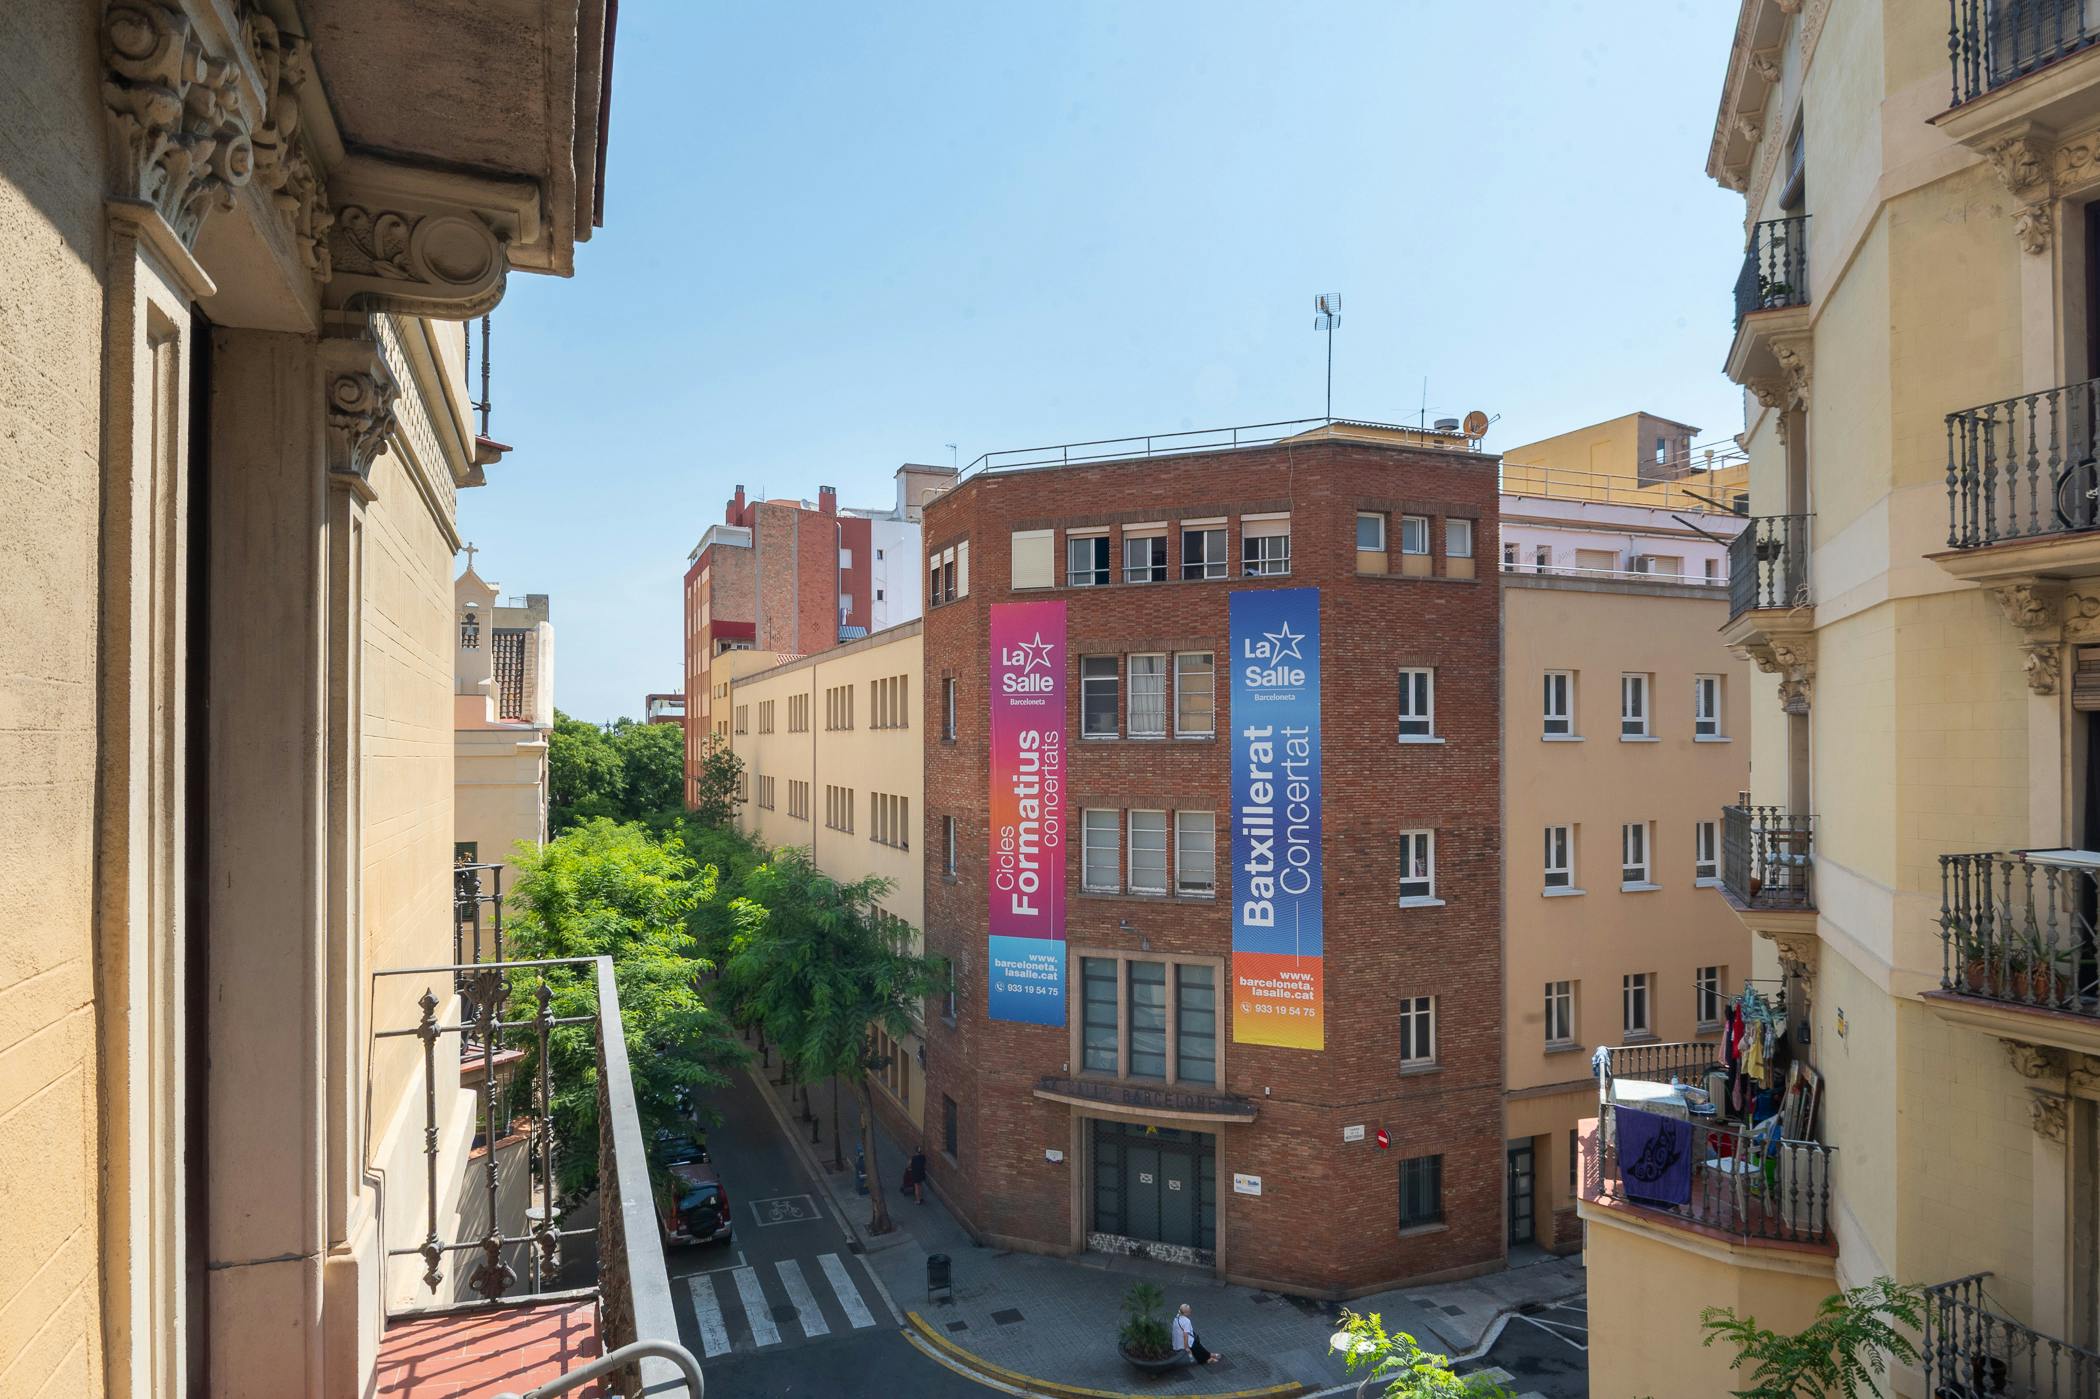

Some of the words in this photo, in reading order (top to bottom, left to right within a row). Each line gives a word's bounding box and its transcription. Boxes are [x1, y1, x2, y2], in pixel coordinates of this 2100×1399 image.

[1244, 638, 1270, 658] La
[1002, 647, 1025, 666] La
[1002, 672, 1054, 692] Salle
[1245, 666, 1306, 687] Salle
[1010, 698, 1046, 706] Barceloneta
[1254, 692, 1296, 702] Barceloneta
[1041, 730, 1059, 847] concertats
[1280, 725, 1311, 895] Concertat
[1012, 729, 1040, 916] Formatius
[1242, 725, 1275, 928] Batxillerat
[996, 825, 1015, 891] Cicles
[994, 958, 1058, 972] barceloneta.
[1029, 953, 1058, 963] www.
[1005, 967, 1058, 980] lasalle.cat
[1280, 971, 1314, 981] www.
[1007, 983, 1023, 993] 933
[1024, 985, 1034, 994] 19
[1035, 986, 1046, 995] 54
[1048, 987, 1059, 996] 75
[1240, 976, 1314, 991] barceloneta.
[1252, 987, 1314, 1000] lasalle.cat
[1255, 1004, 1273, 1014] 933
[1276, 1006, 1287, 1015] 19
[1289, 1007, 1301, 1016] 54
[1303, 1007, 1316, 1017] 75
